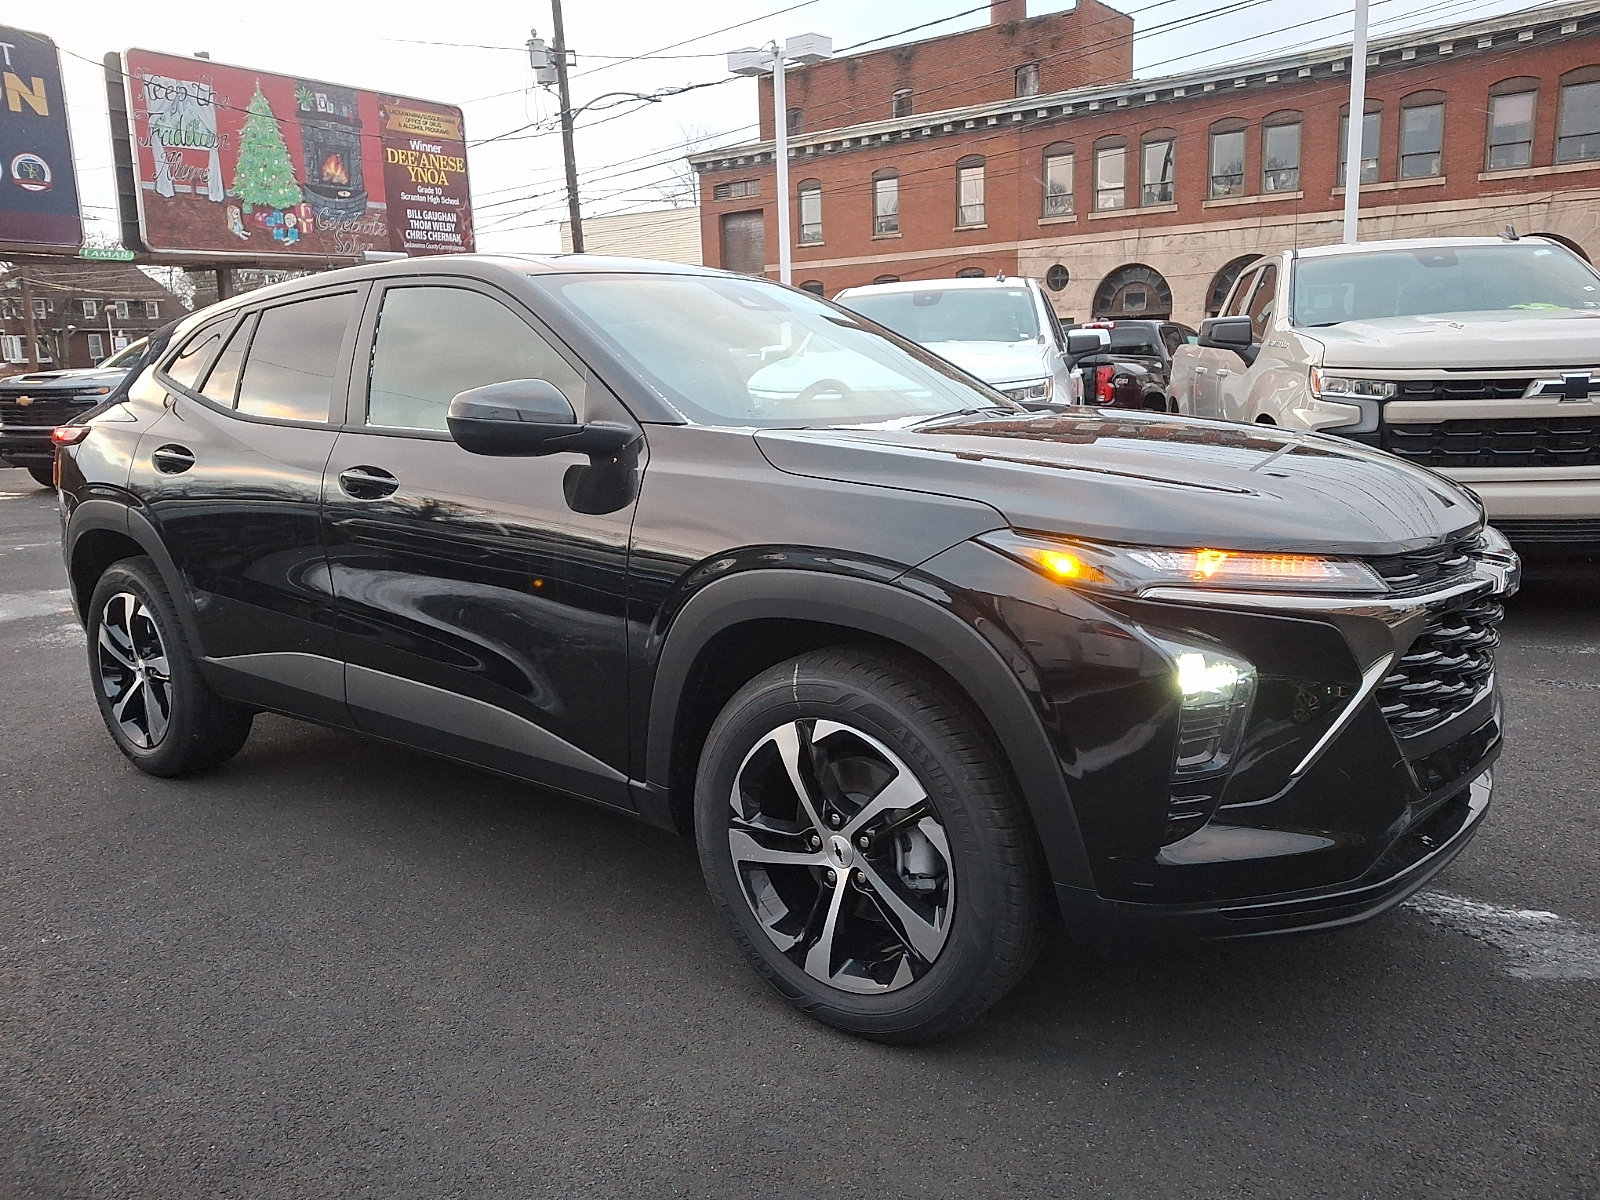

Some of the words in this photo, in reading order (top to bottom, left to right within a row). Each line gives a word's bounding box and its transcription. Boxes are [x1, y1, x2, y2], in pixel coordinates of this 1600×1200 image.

[0, 72, 49, 117] N
[403, 123, 424, 132] ALCOHOL
[424, 126, 450, 135] PROGRAMS
[405, 117, 421, 126] OFFICE
[421, 119, 429, 127] OF
[429, 120, 442, 128] DRUG
[409, 139, 442, 154] Winner
[385, 147, 466, 173] DEE'ANESE
[407, 165, 450, 186] YNOA
[417, 185, 434, 195] Grade
[434, 187, 442, 195] 10
[400, 191, 426, 202] Scranton
[427, 195, 440, 205] High
[440, 196, 460, 206] School
[406, 208, 422, 219] BILL
[422, 210, 457, 222] GAUGHAN
[409, 219, 431, 230] THOM
[432, 221, 456, 232] WELBY
[405, 229, 427, 241] CHRIS
[427, 231, 462, 245] CHERMAK
[425, 242, 439, 251] County
[84, 249, 130, 259] LAMAR
